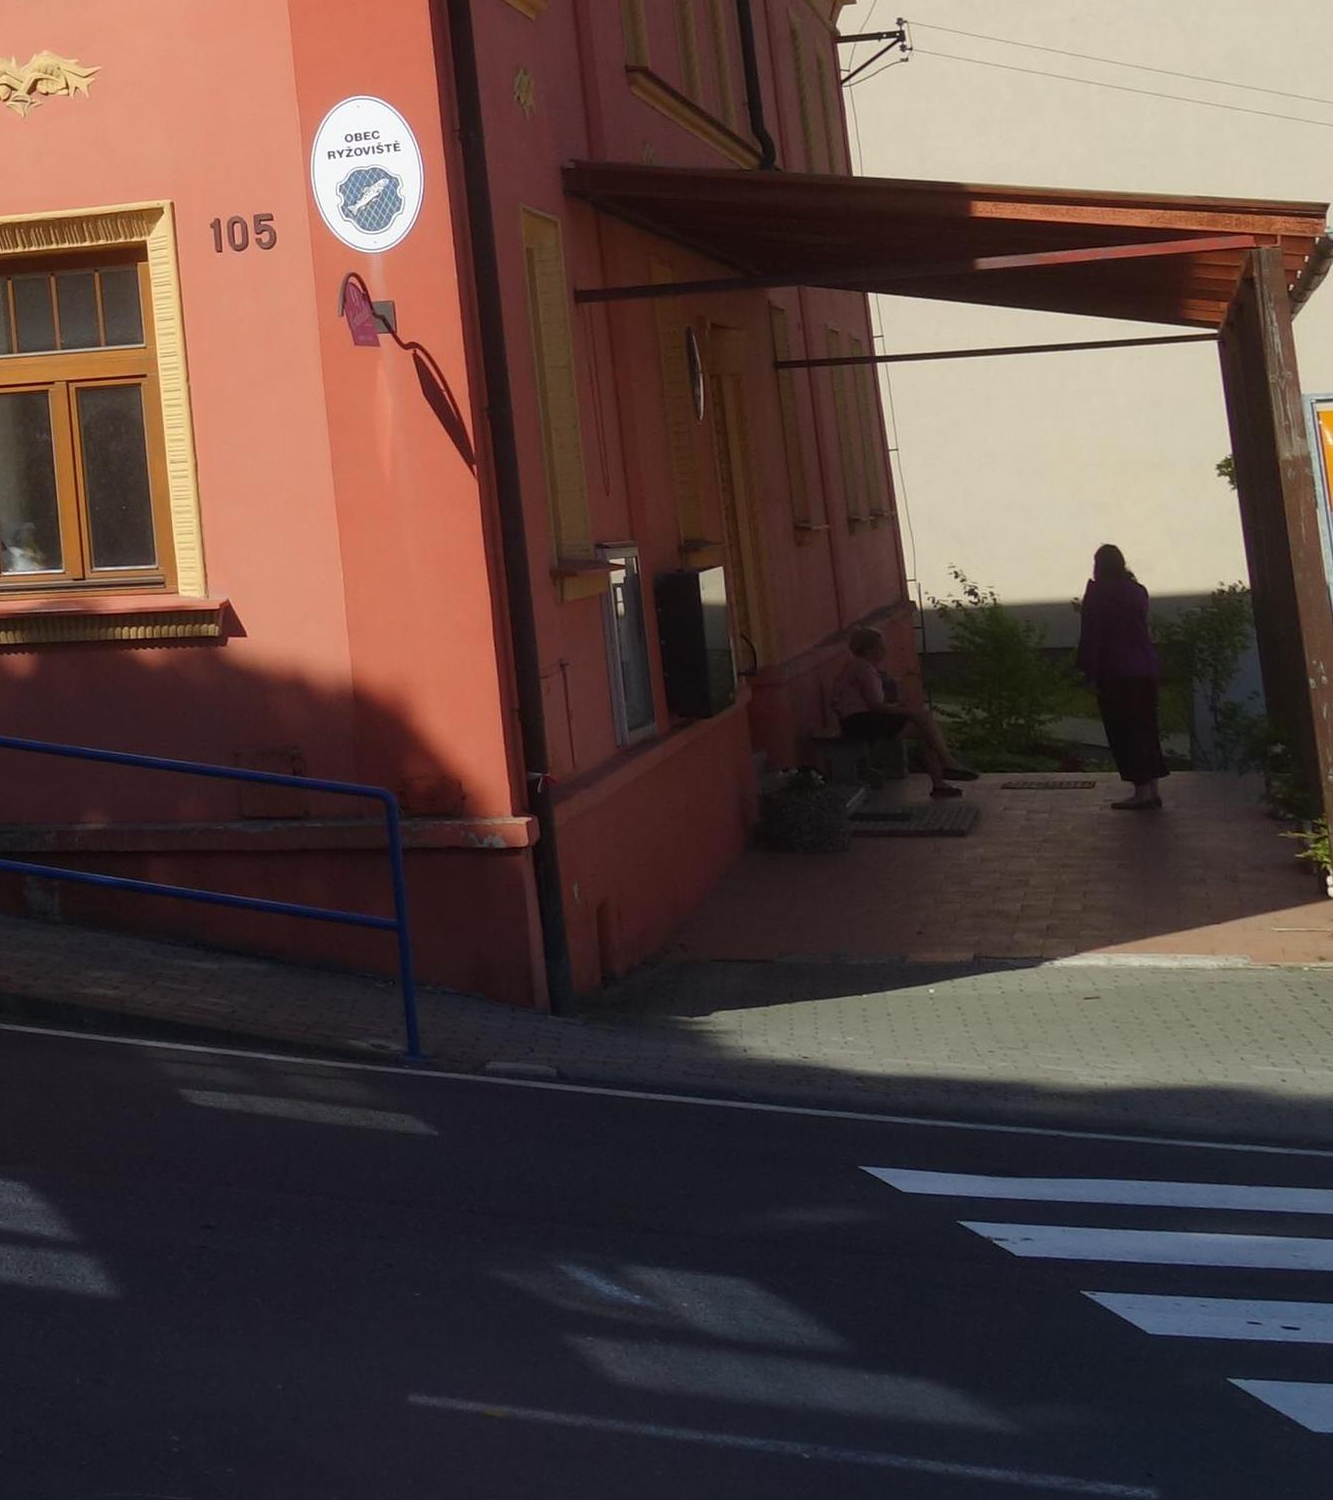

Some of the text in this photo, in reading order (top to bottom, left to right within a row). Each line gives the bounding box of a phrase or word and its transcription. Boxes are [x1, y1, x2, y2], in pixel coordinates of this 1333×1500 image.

[344, 130, 380, 143] OBEC
[327, 140, 401, 160] RYŽOVIŠTĚ
[210, 213, 277, 253] 105
